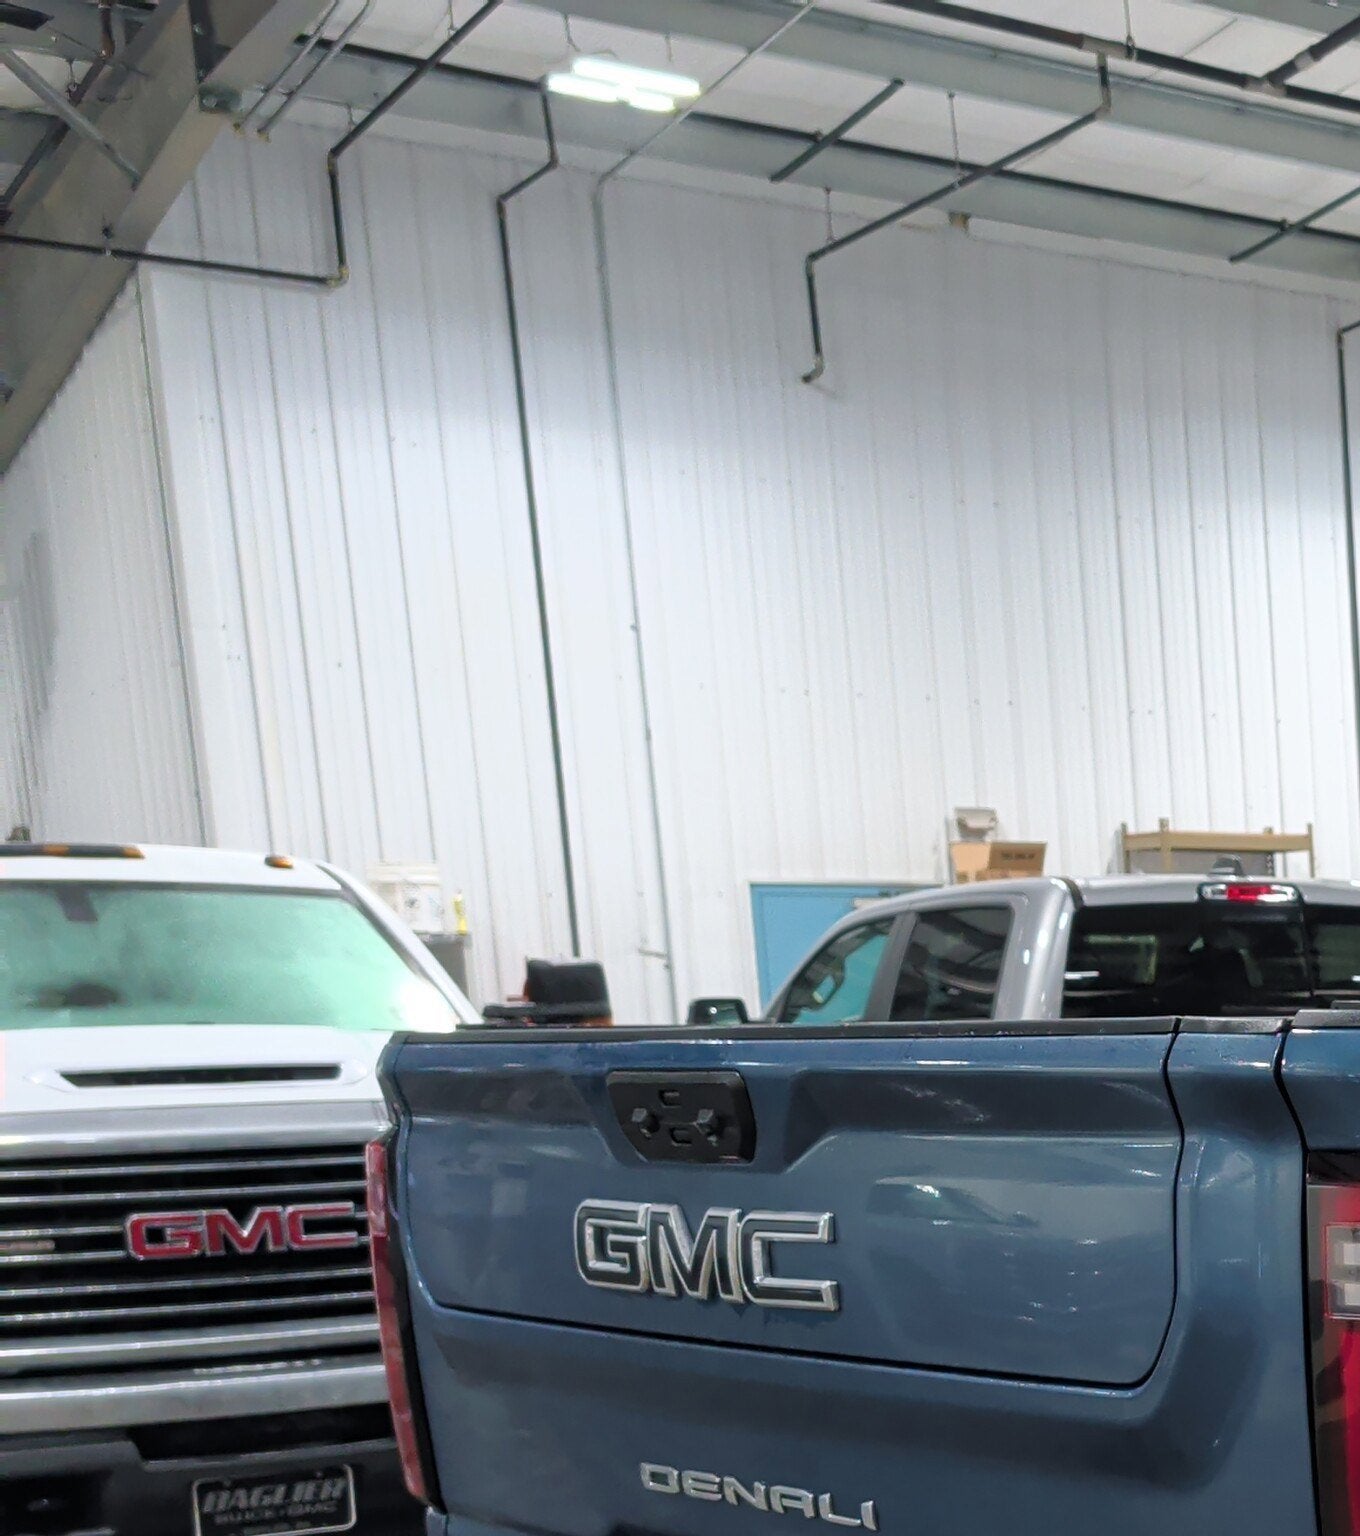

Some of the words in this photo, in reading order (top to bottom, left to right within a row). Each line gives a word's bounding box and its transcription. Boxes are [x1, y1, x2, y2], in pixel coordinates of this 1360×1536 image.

[125, 1201, 359, 1260] GMC
[574, 1199, 840, 1312] GMC
[640, 1462, 880, 1531] DENALI
